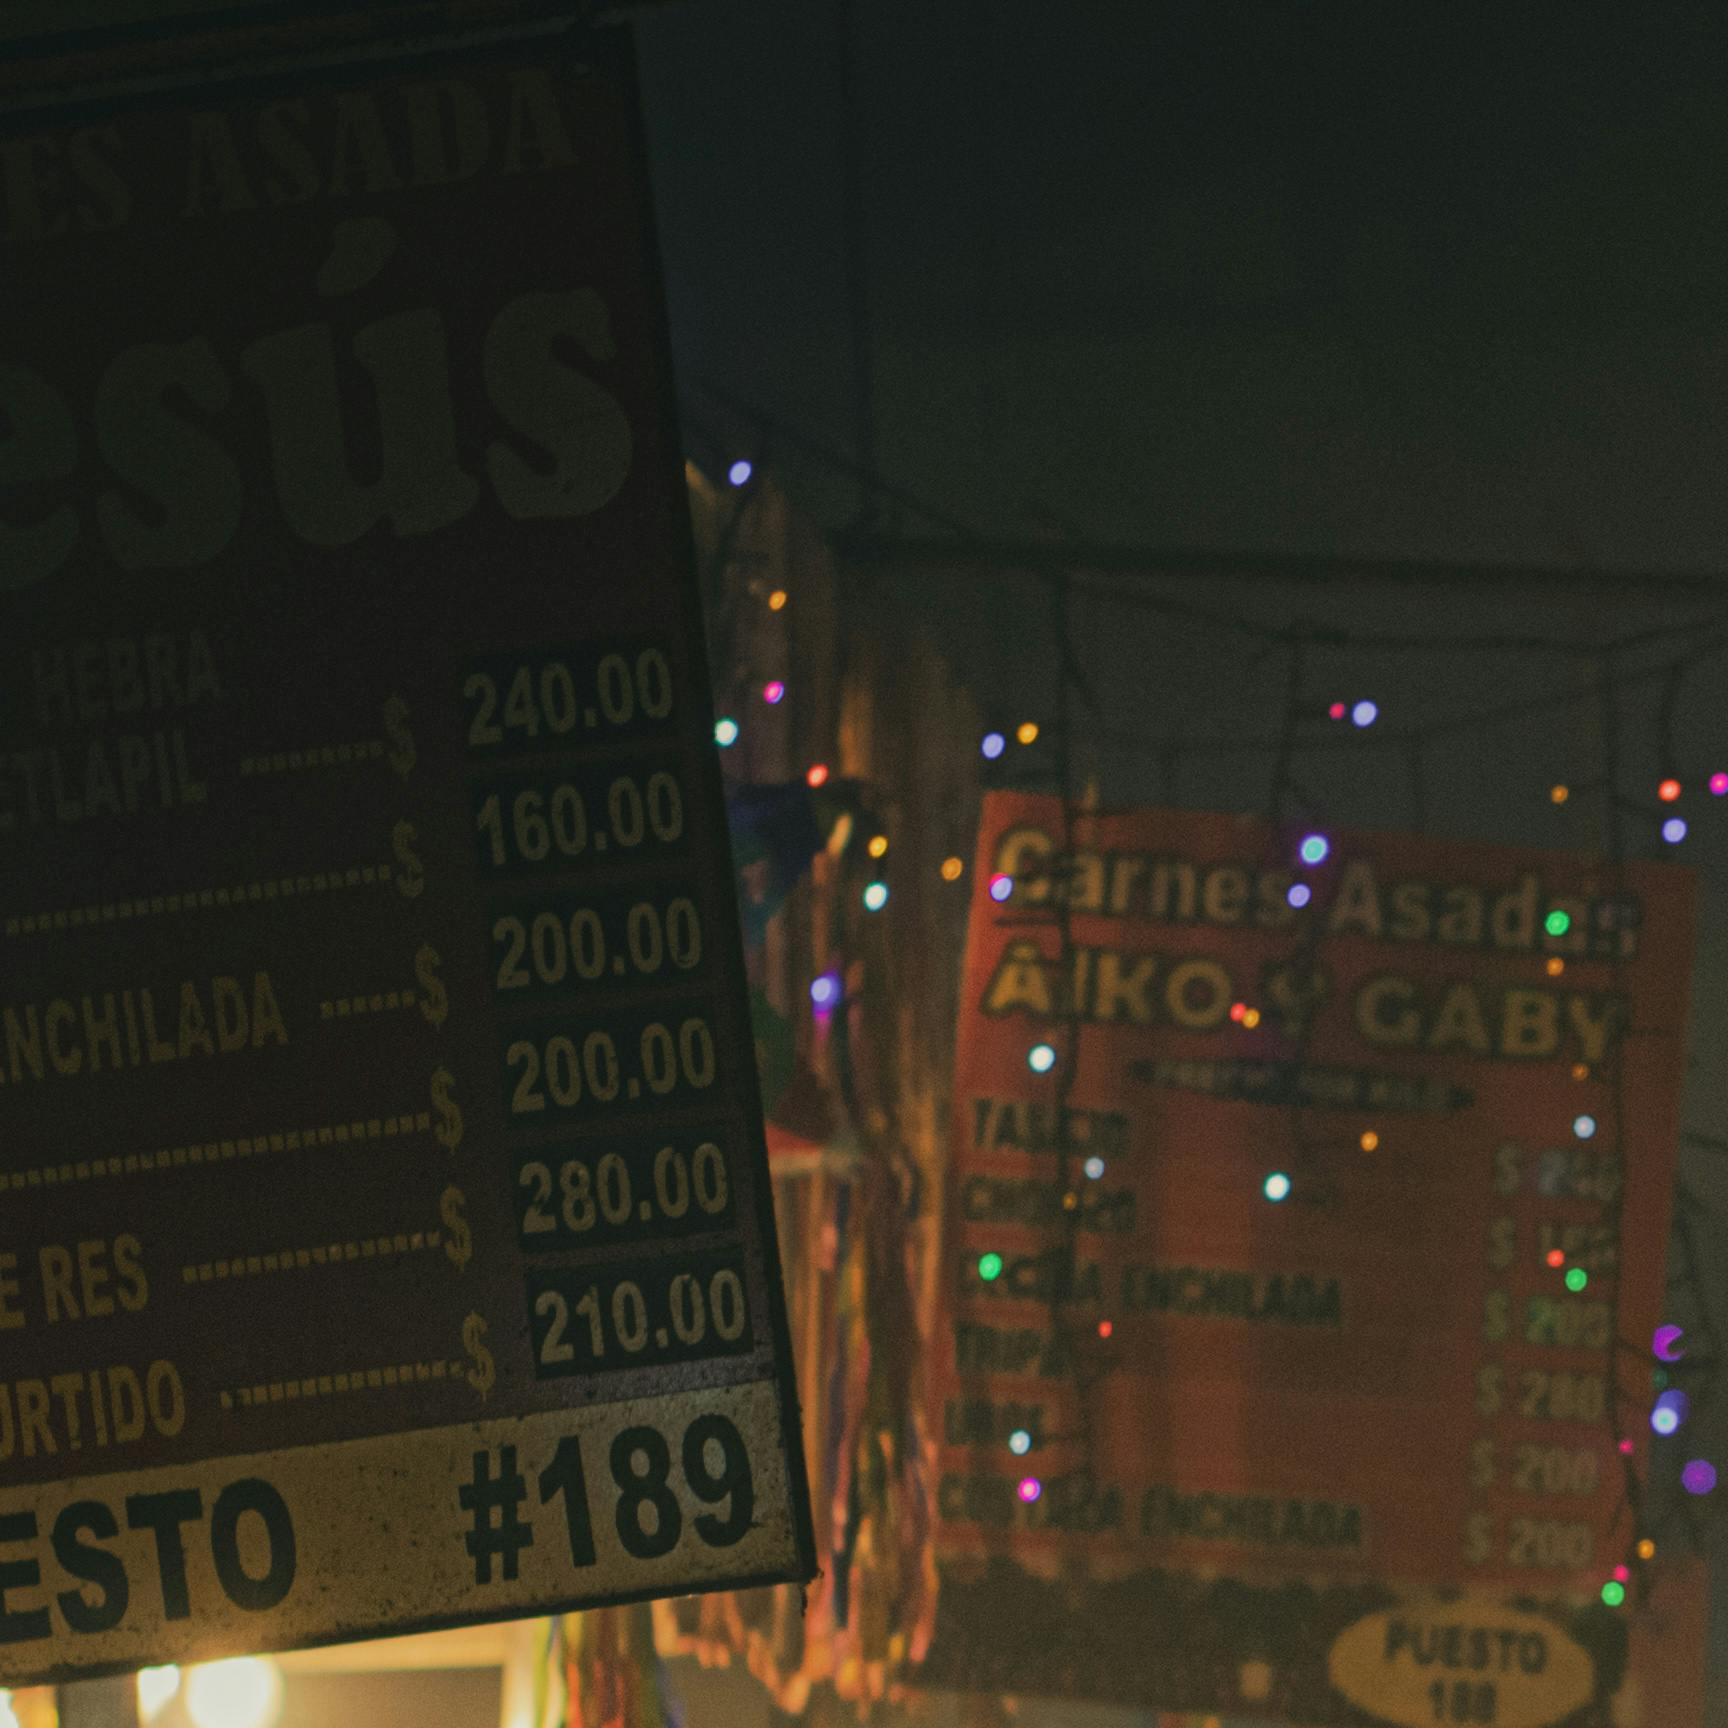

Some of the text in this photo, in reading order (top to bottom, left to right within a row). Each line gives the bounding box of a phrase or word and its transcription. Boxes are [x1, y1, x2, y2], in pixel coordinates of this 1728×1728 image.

[182, 67, 581, 218] ASADA
[32, 626, 228, 728] HEBRA
[463, 647, 674, 747] 240.00
[383, 691, 418, 782] $
[391, 770, 685, 900] $ 160.00
[996, 829, 1298, 930] Carnes
[491, 896, 703, 991] 200.00
[0, 941, 449, 1086] NCHILADA $
[1355, 974, 1622, 1066] GABY
[429, 1016, 717, 1154] $ 200.00
[40, 1233, 151, 1325] RES
[440, 1184, 474, 1272] $
[518, 1141, 730, 1236] 280.00
[462, 1310, 497, 1400] $
[534, 1267, 747, 1367] 210.00
[0, 1412, 757, 1646] ESTO #189
[1383, 1621, 1549, 1675] PUESTO
